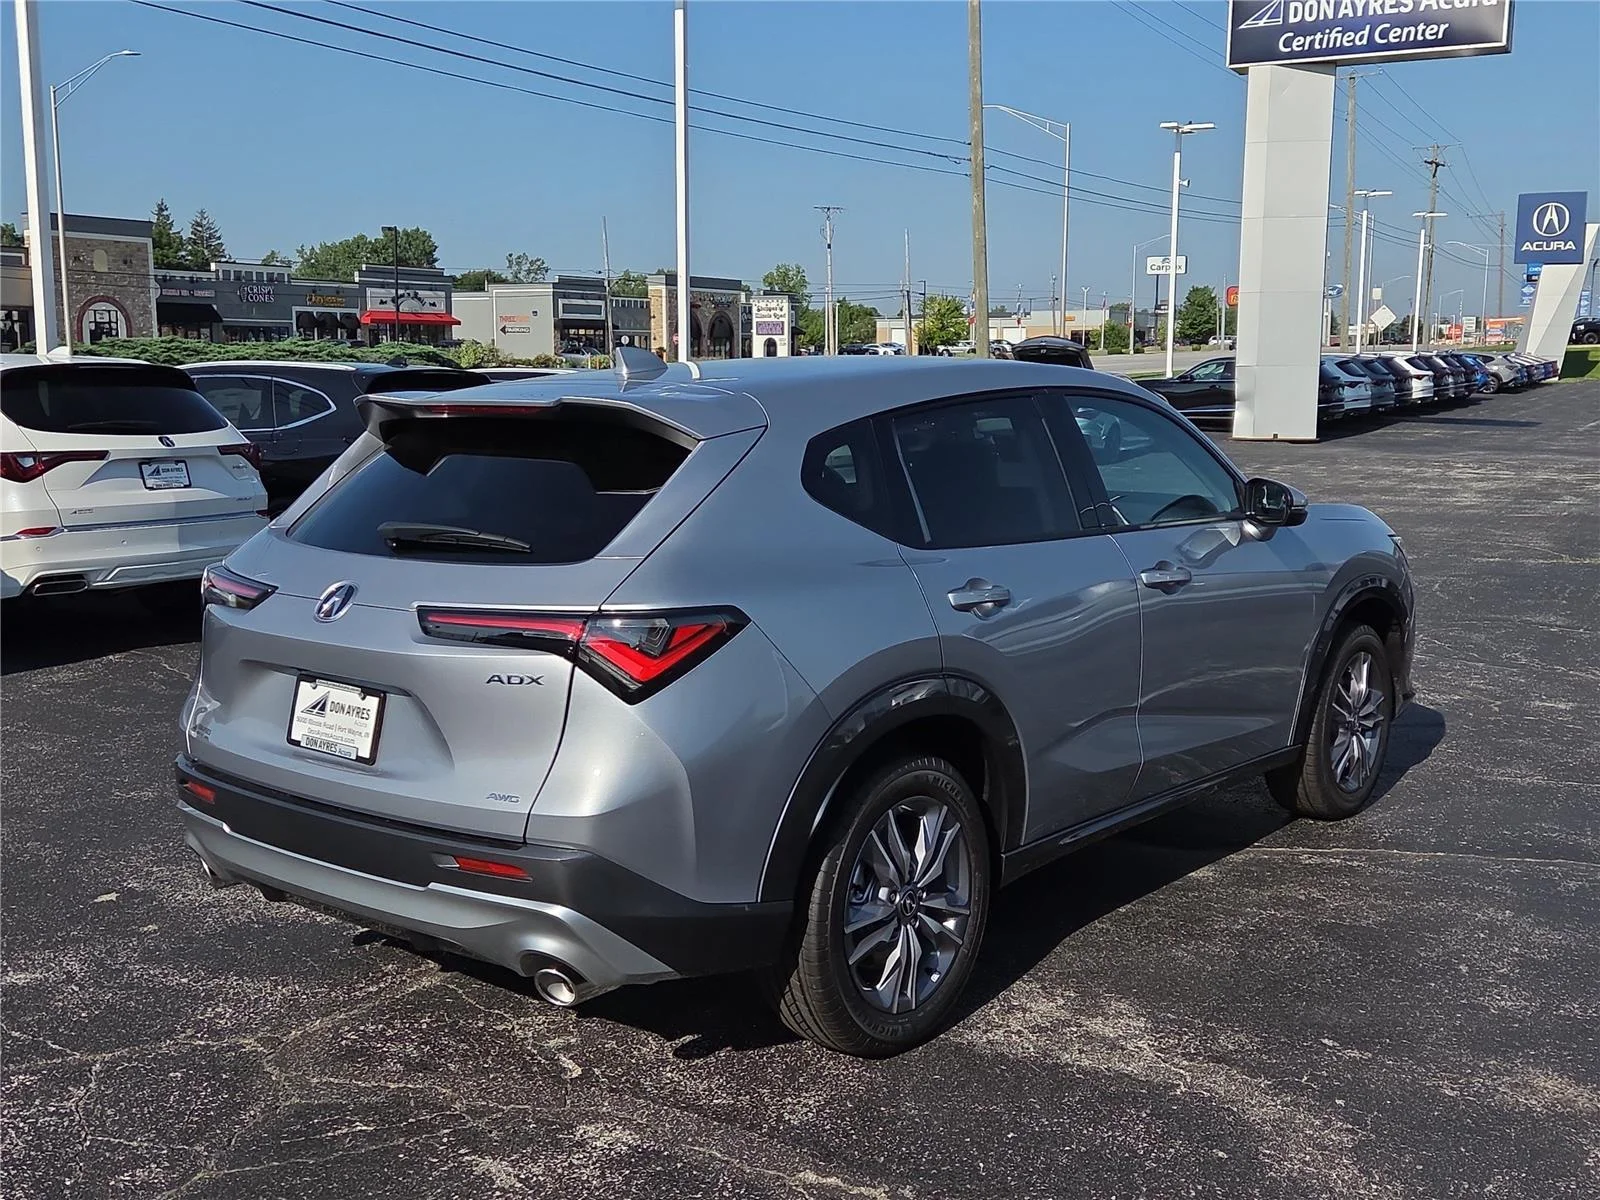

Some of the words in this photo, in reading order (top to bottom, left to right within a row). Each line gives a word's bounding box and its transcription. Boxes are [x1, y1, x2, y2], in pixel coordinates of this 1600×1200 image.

[1289, 0, 1335, 23] DON
[1338, 0, 1414, 18] AYRES
[1278, 25, 1370, 53] Certified
[1374, 22, 1449, 44] Center
[1521, 241, 1576, 251] ACURA
[1150, 263, 1182, 272] Carpx
[248, 284, 274, 295] CRISPY
[248, 294, 275, 303] CONES
[486, 674, 544, 686] ADX
[329, 701, 345, 715] DON
[345, 704, 371, 721] AYRES
[305, 737, 318, 747] DON
[318, 739, 337, 753] AYRES
[338, 748, 352, 757] Acura
